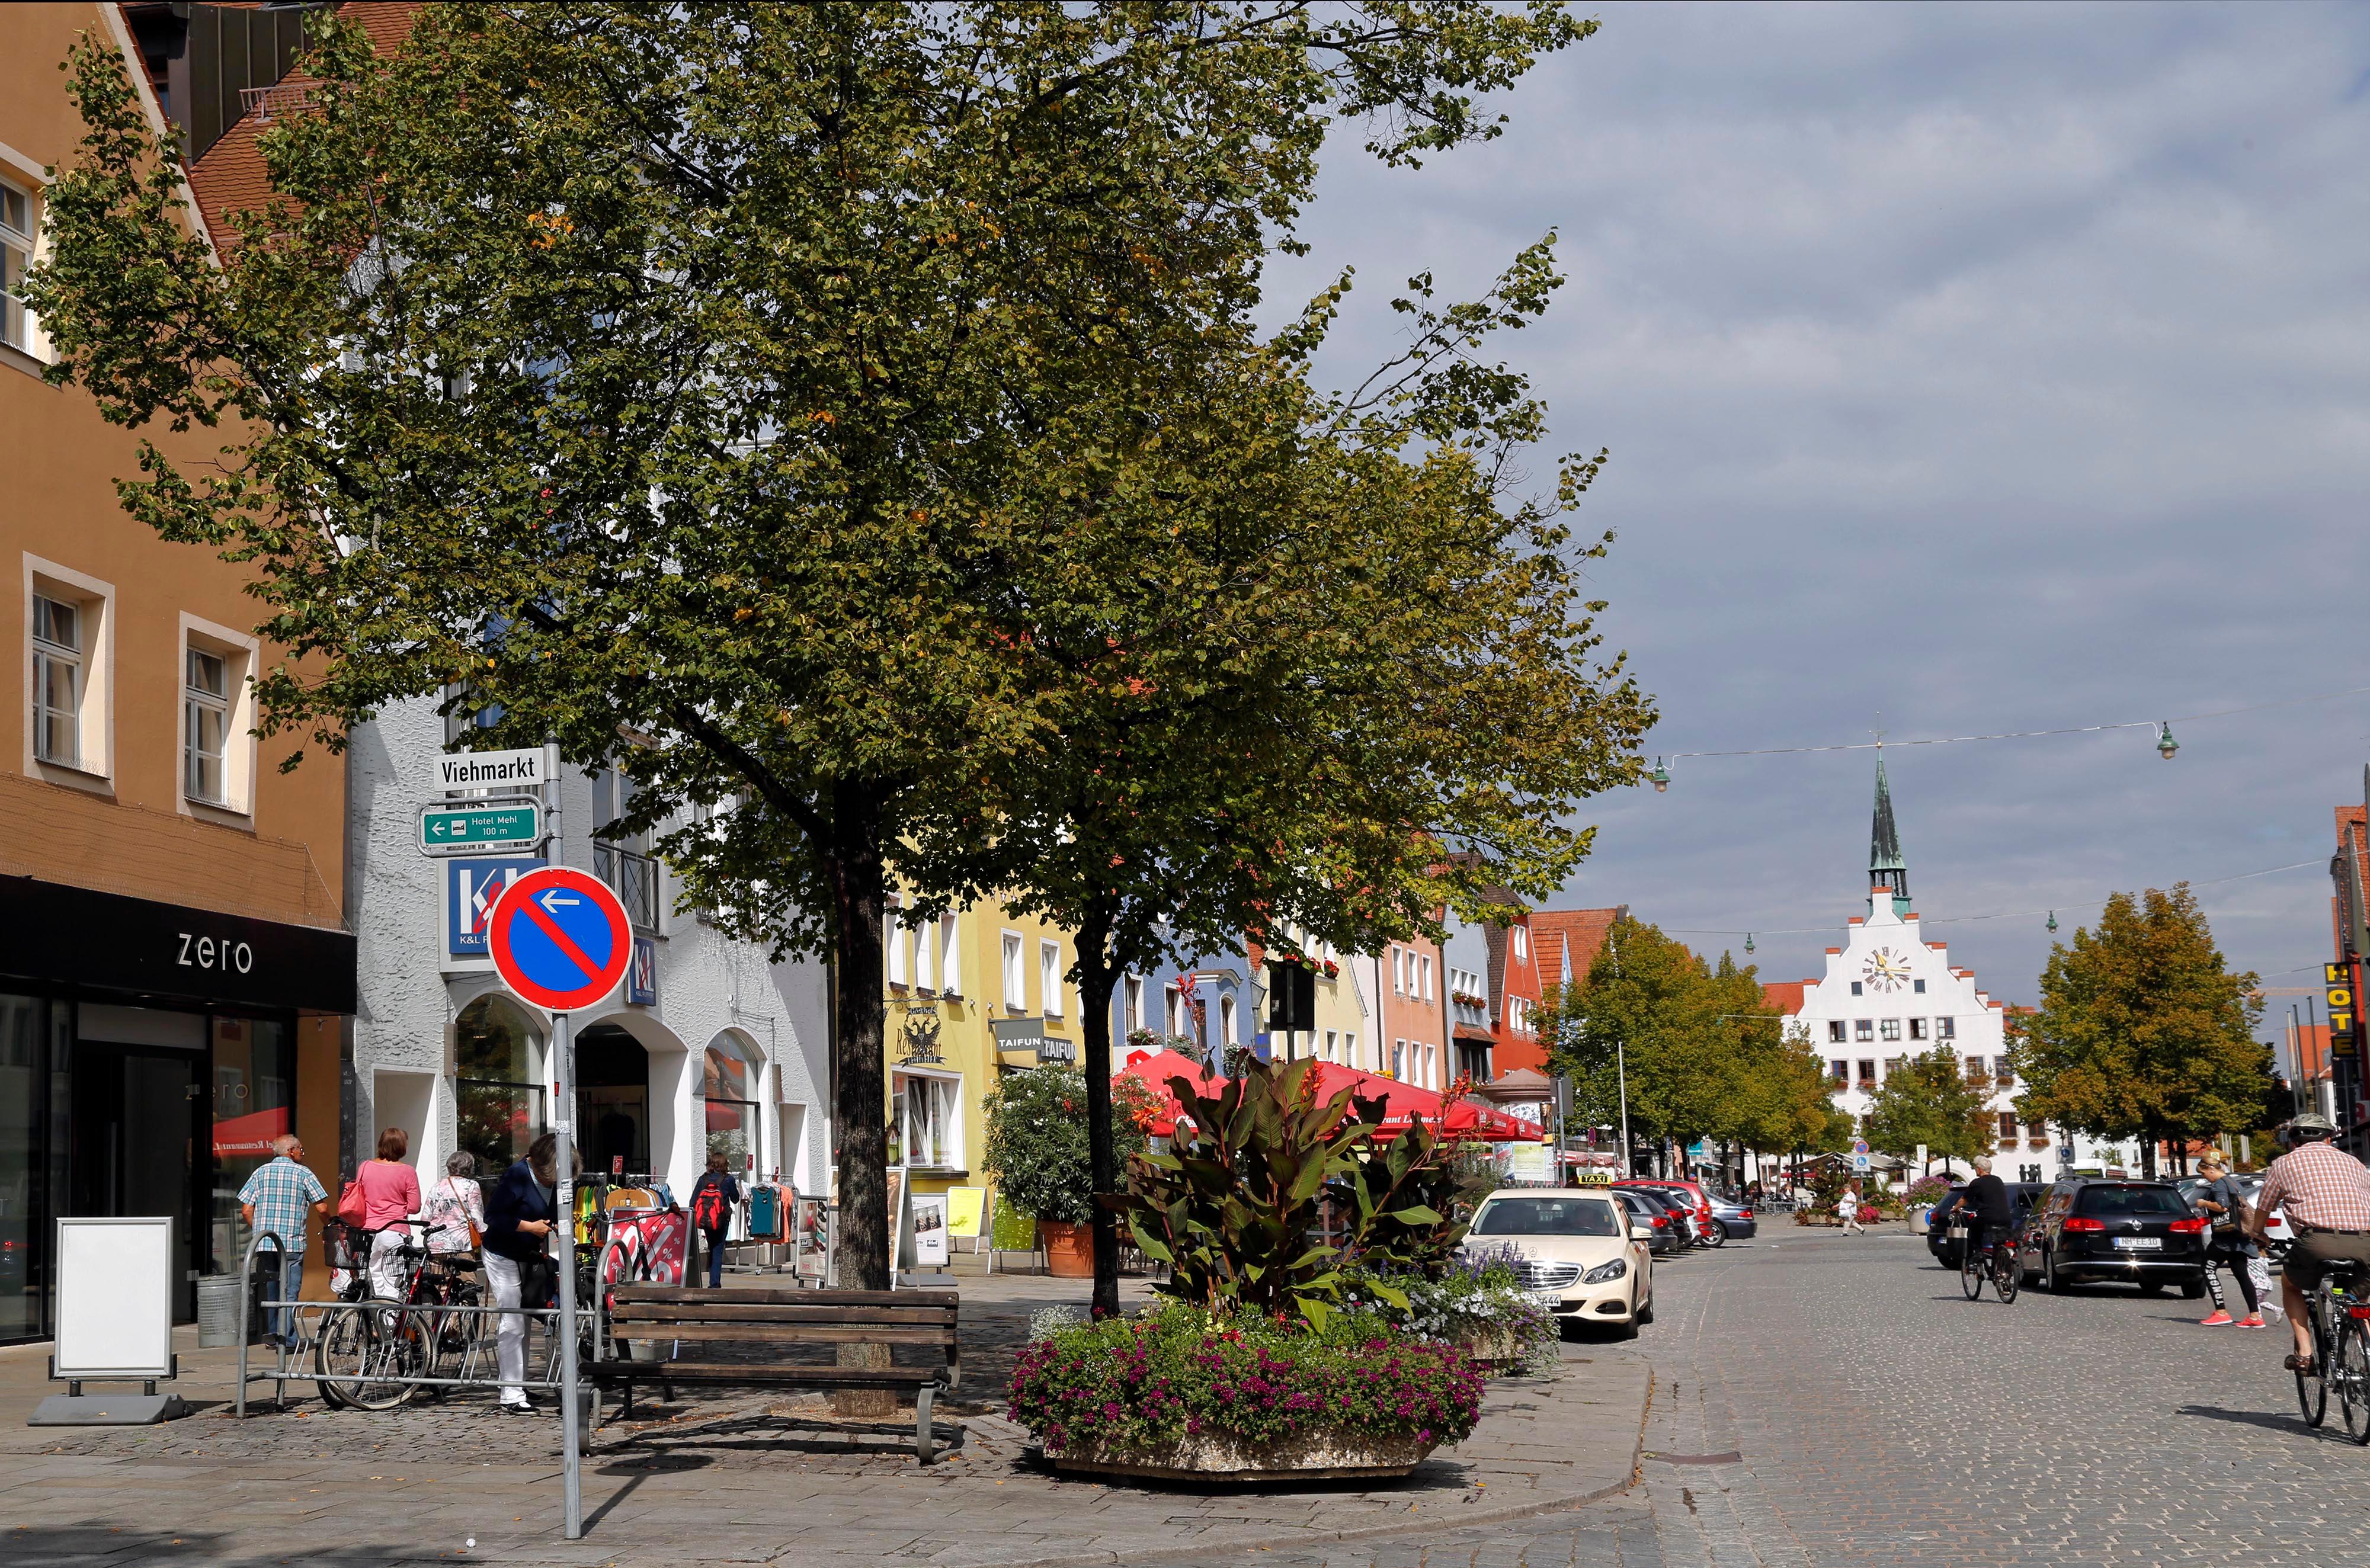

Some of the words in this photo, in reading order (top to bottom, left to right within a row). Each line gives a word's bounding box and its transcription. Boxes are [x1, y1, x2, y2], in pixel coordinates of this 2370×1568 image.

[441, 757, 535, 783] Viehmarkt
[472, 817, 494, 825] Hotel
[497, 816, 517, 824] Mehl
[178, 933, 252, 974] zero
[998, 1037, 1040, 1047] TAIFUN
[1044, 1040, 1077, 1060] TAIFUN
